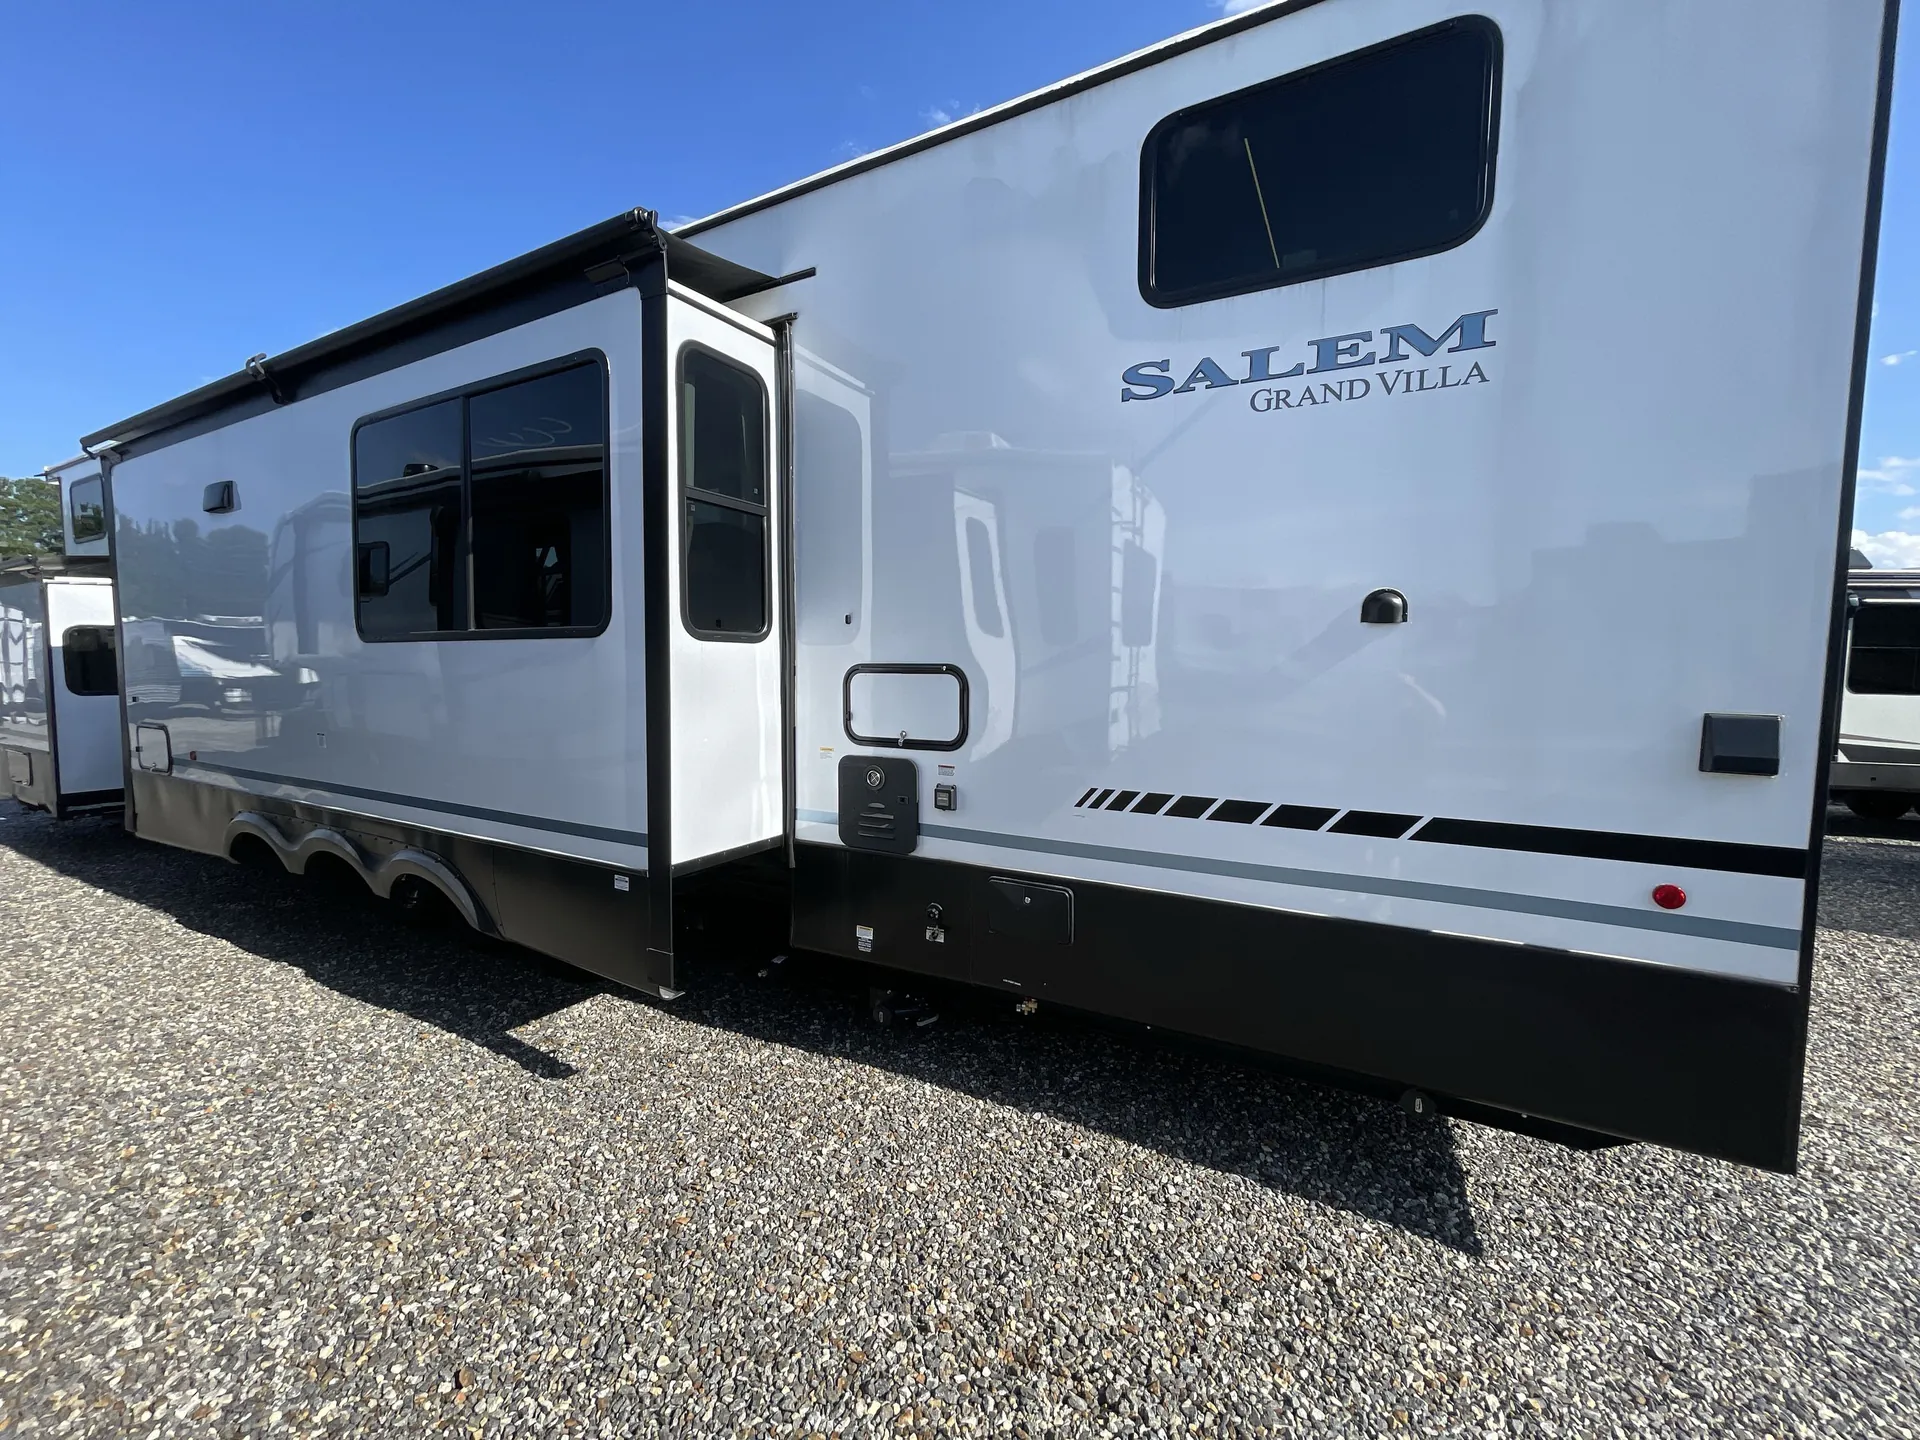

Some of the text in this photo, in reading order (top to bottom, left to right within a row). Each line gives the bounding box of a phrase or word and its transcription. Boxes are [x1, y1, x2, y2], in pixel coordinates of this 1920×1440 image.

[1121, 309, 1498, 402] SALEM
[1250, 361, 1490, 412] GRAND VILLA
